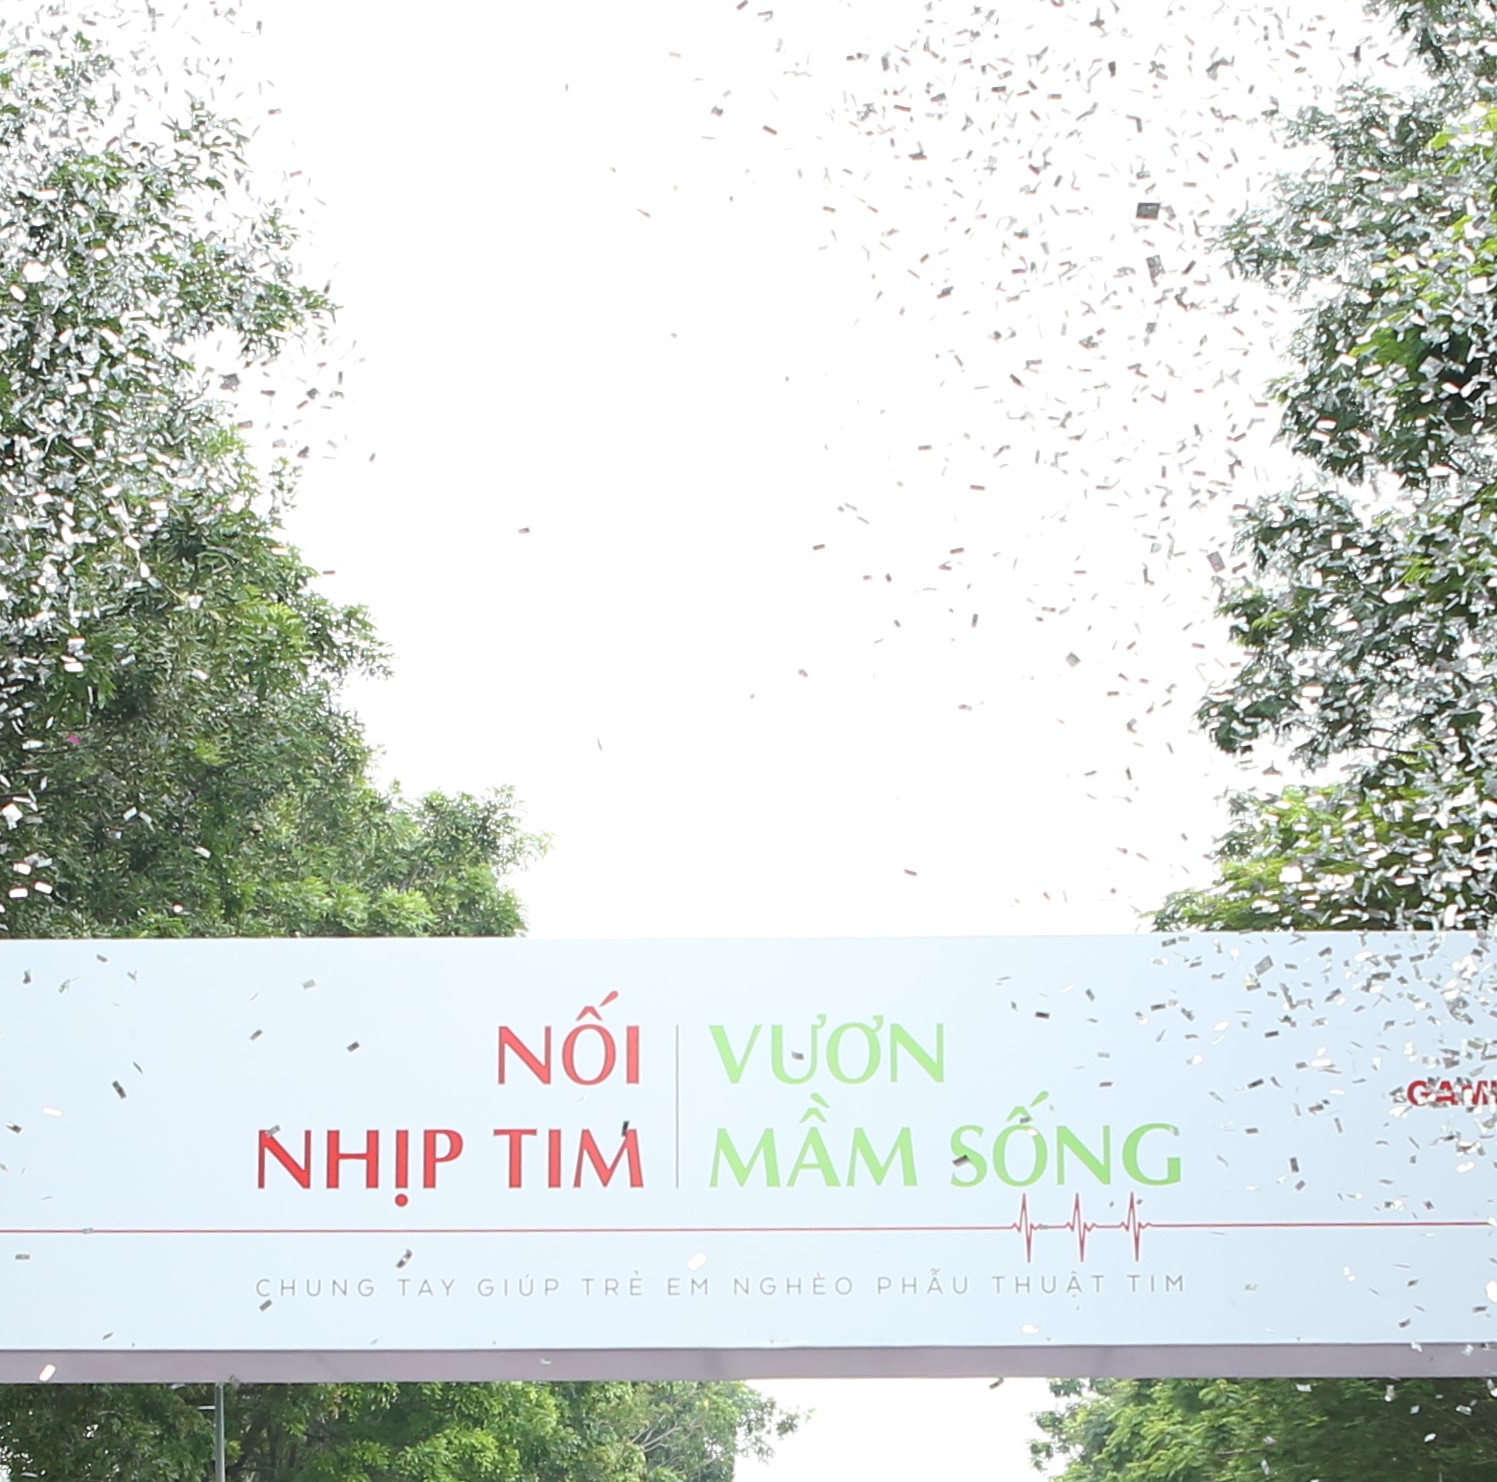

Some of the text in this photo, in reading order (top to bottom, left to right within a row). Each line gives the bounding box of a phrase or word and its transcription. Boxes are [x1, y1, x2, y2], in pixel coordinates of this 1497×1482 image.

[497, 991, 641, 1085] NỐI
[707, 1013, 946, 1085] VƯƠN
[255, 1126, 646, 1208] NHỊP TIM
[707, 1090, 1184, 1189] MẦM SỐNG
[255, 1266, 1187, 1300] CHUNG TAY GIÚP TRẺ EM NGHÈO PHẪU THUẬT TIM
